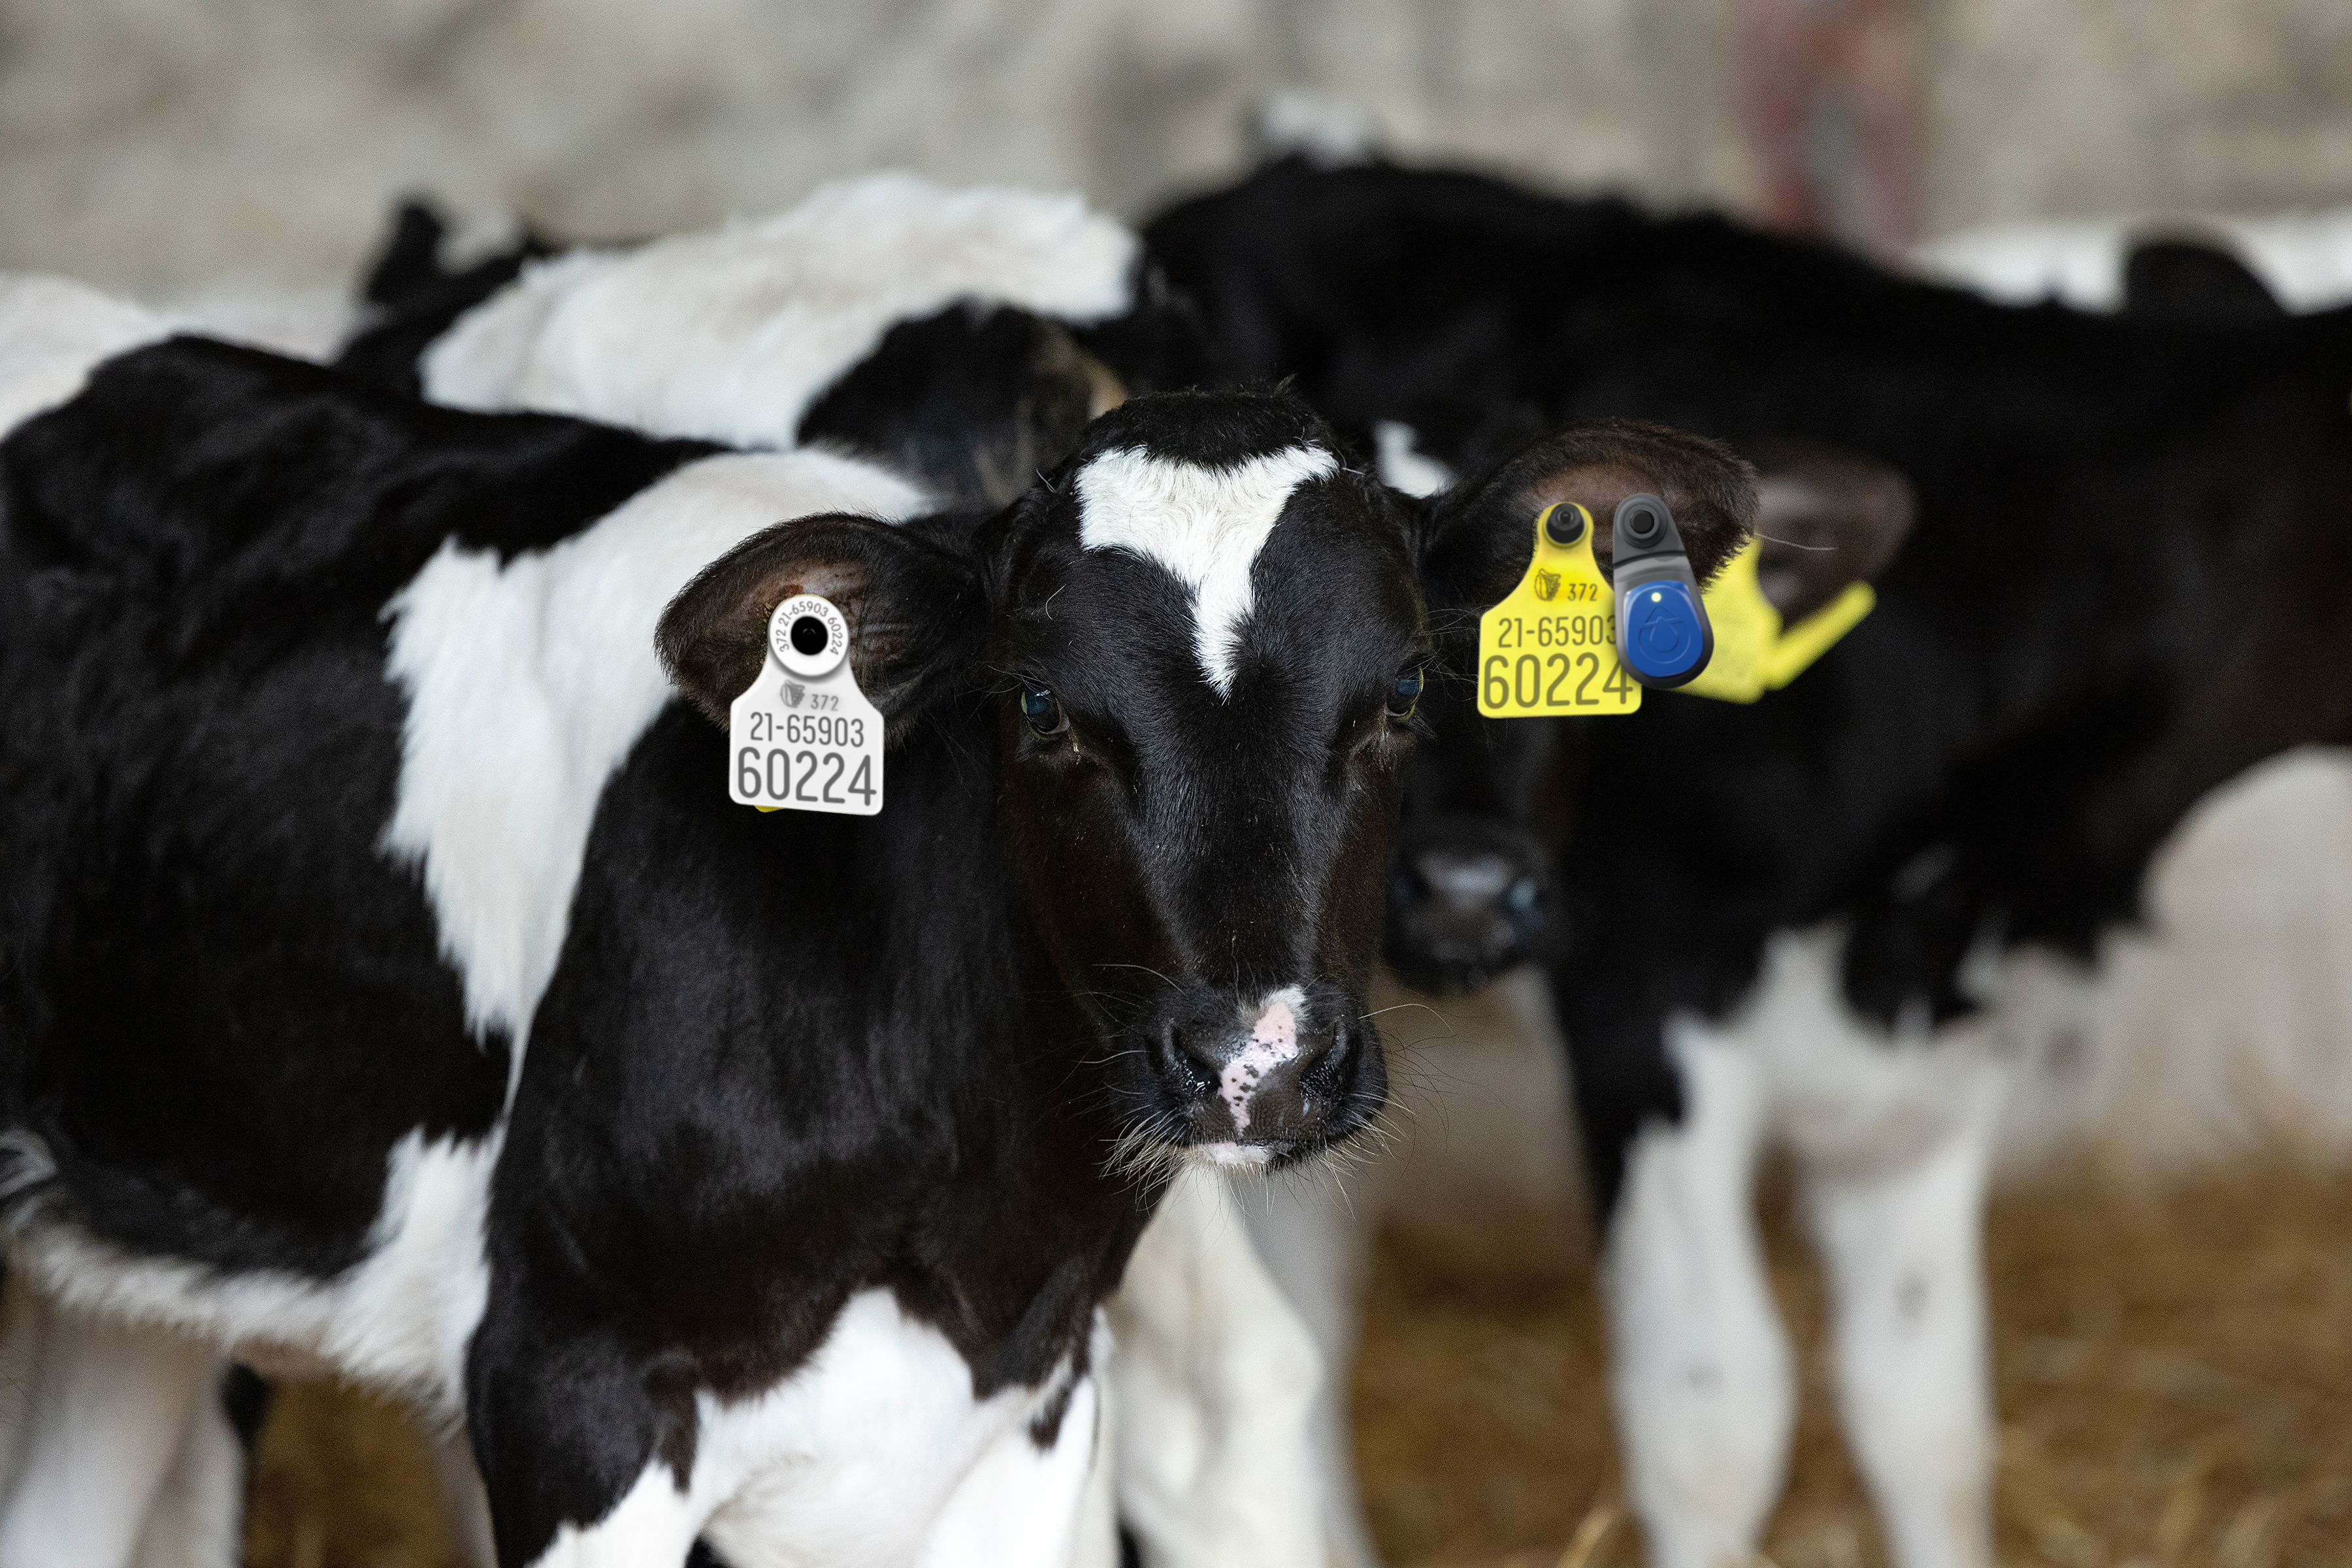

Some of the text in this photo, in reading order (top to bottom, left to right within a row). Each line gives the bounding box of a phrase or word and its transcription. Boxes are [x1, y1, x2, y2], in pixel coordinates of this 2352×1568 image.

[1567, 583, 1598, 602] 372
[775, 600, 843, 656] 372 21-65903 60224
[810, 693, 840, 712] 372
[1483, 651, 1634, 710] 60224
[750, 711, 864, 748] 21-65903
[738, 746, 877, 807] 60224
